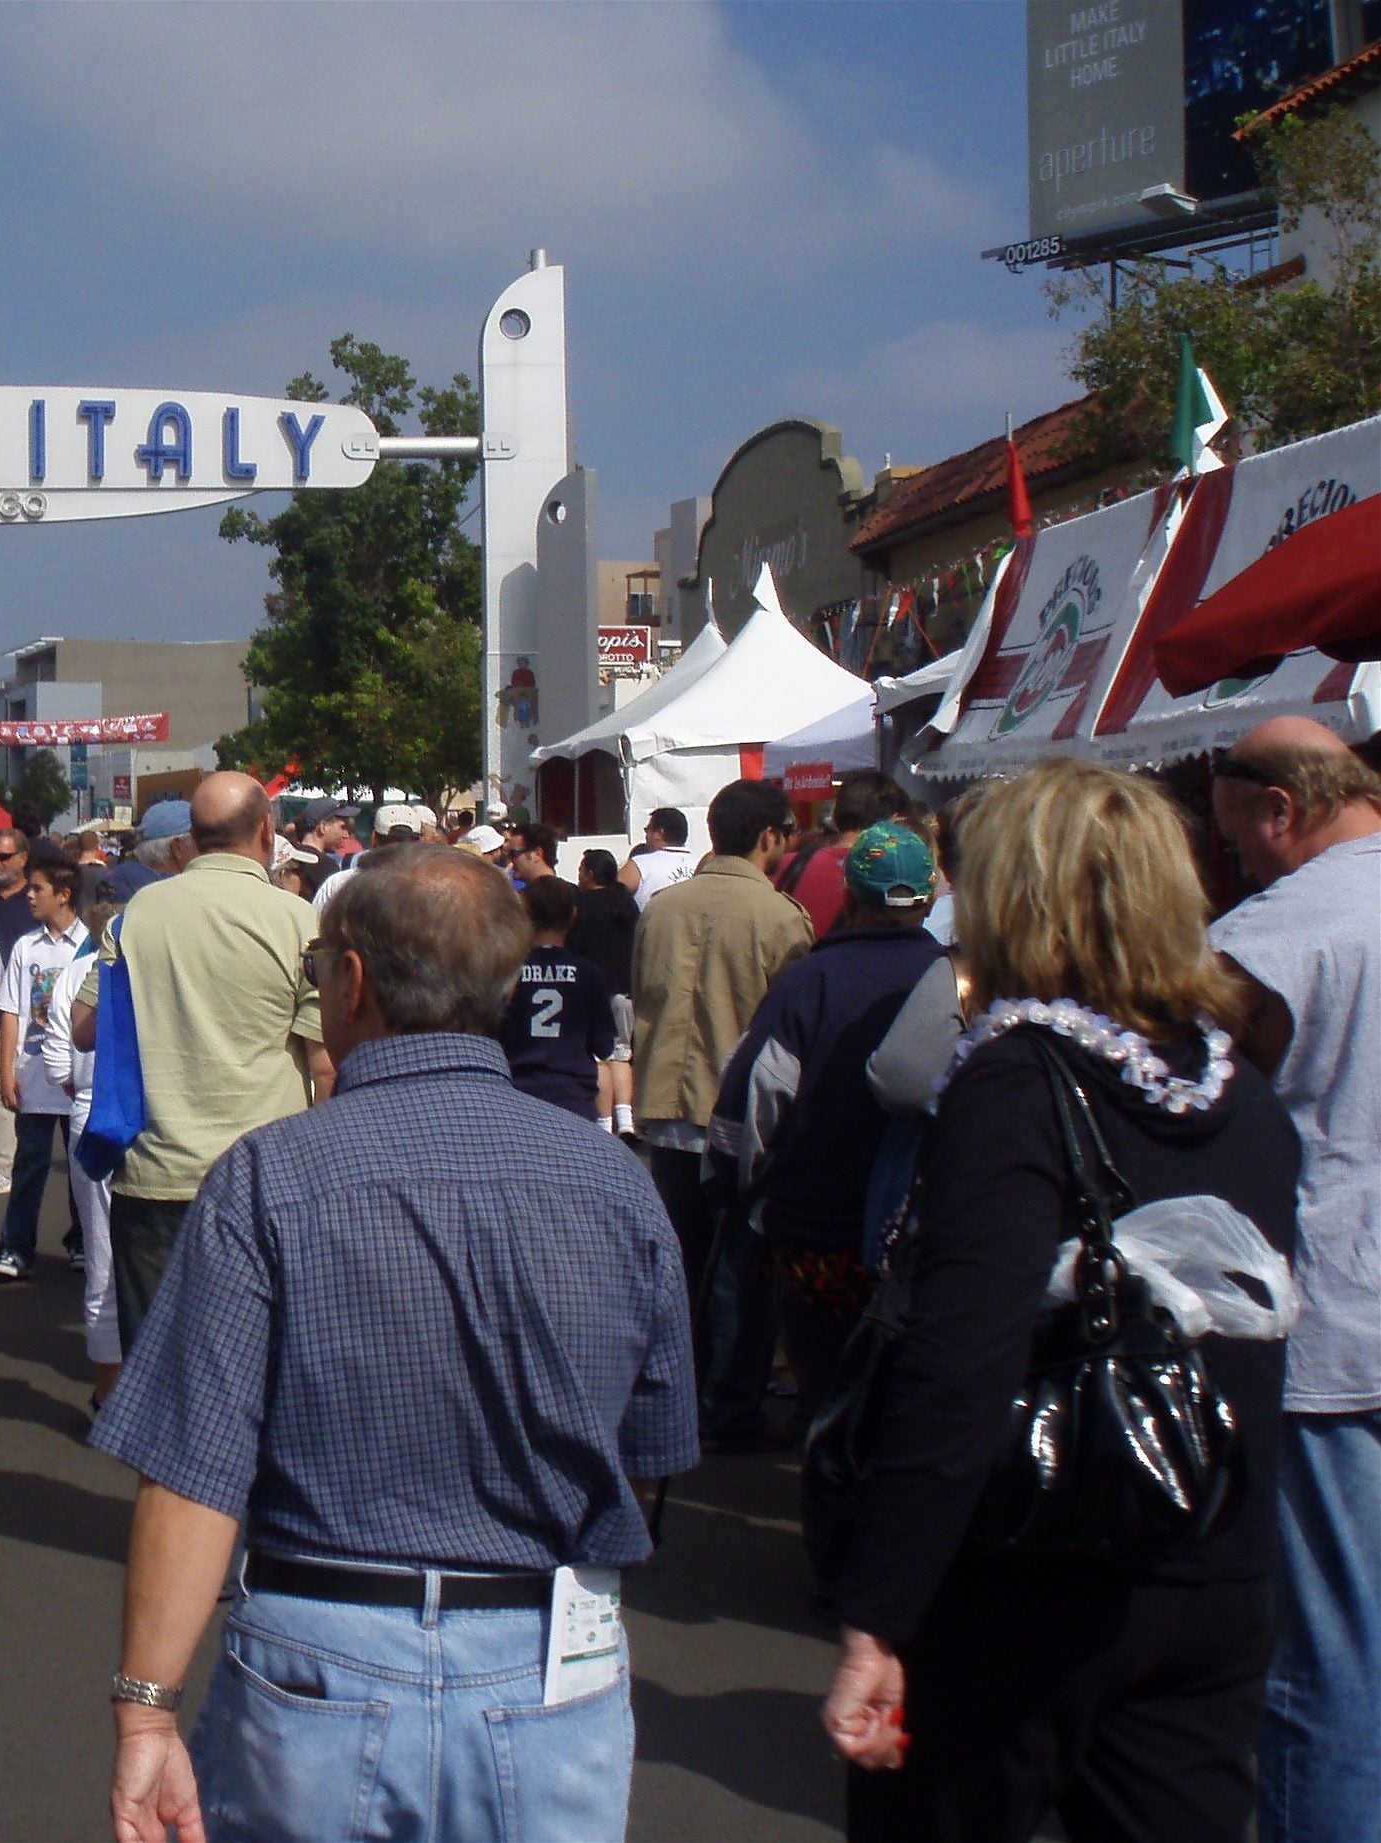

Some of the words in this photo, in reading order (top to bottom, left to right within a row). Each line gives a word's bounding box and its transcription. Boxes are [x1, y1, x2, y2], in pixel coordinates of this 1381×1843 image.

[1070, 0, 1120, 33] MAKE
[1044, 33, 1100, 68] LITTLE
[1103, 19, 1148, 52] ITALY
[1070, 56, 1119, 89] HOME
[1039, 124, 1156, 193] aperture
[1005, 236, 1060, 265] 001285
[29, 398, 327, 479] ITALY
[521, 965, 577, 983] DRAKE
[530, 988, 563, 1037] 2
